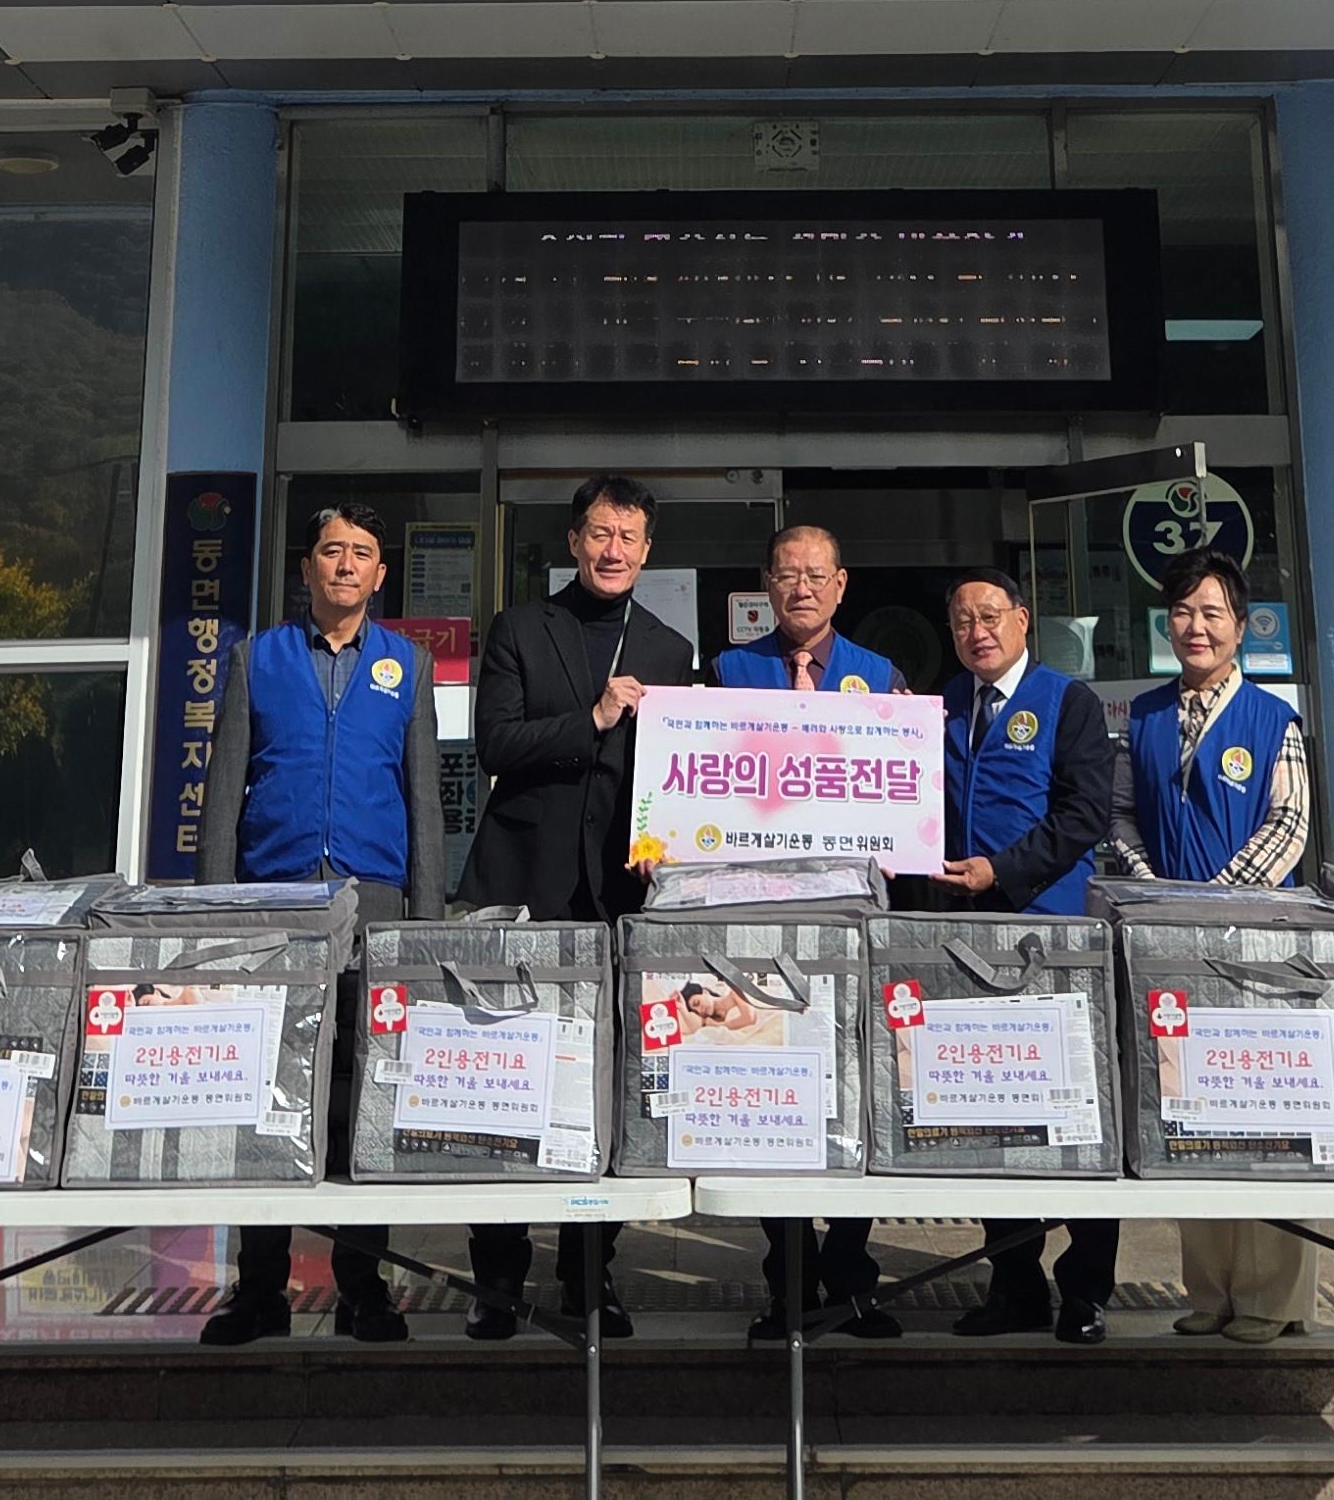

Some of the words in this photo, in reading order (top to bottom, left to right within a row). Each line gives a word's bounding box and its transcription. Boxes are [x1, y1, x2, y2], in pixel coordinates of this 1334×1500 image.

[1152, 520, 1224, 555] 37
[396, 626, 457, 653] 급기
[661, 752, 768, 798] 사랑의
[779, 755, 921, 802] 성품전달
[725, 831, 813, 851] 바르게살기운동
[822, 834, 894, 853] 동면위원회
[135, 1044, 240, 1068] 2인용전기요
[424, 1048, 527, 1071] 2인용전기요
[937, 1043, 1042, 1065] 2인용전기요
[1206, 1049, 1313, 1071] 2인용전기요
[695, 1086, 799, 1108] 2인용전기요
[1011, 1092, 1044, 1105] 동면위
